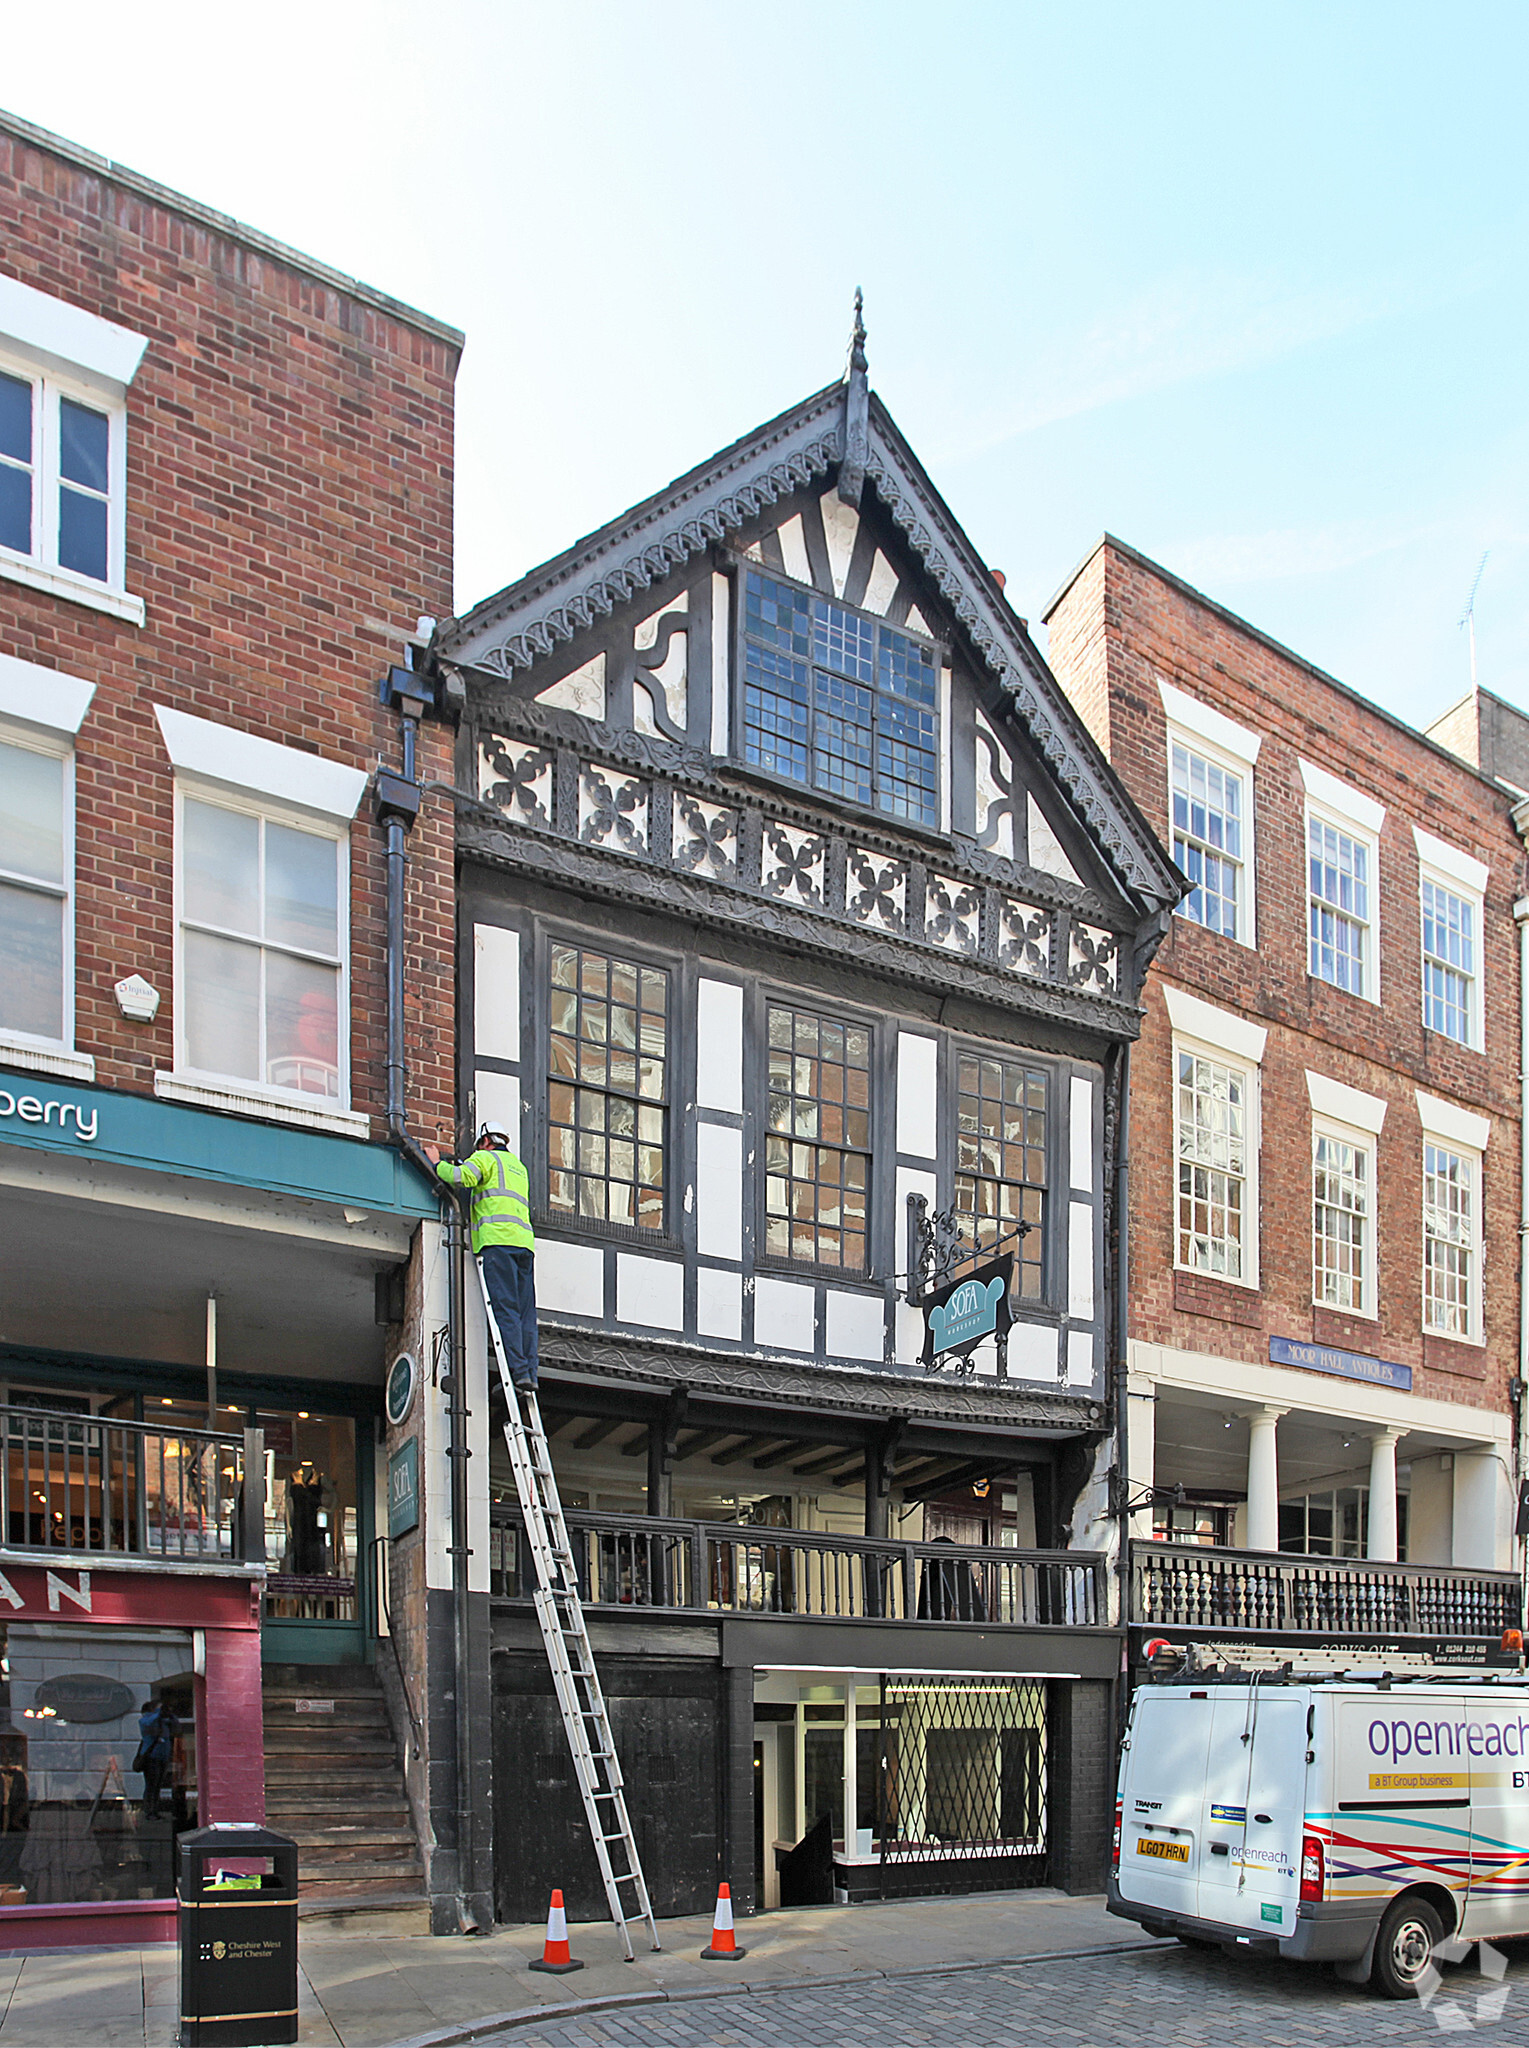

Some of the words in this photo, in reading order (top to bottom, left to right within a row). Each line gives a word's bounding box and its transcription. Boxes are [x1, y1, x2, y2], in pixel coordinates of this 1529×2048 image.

[951, 1285, 979, 1321] SOFA
[1287, 1344, 1316, 1363] MOOR
[1320, 1352, 1345, 1371] HALL
[1352, 1361, 1393, 1380] ANTIQUES
[393, 1462, 411, 1502] SOFA
[1368, 1715, 1529, 1765] openreach
[1375, 1777, 1381, 1787] a
[1382, 1775, 1392, 1787] BT
[1393, 1775, 1418, 1789] Group
[1419, 1773, 1454, 1787] business
[1135, 1800, 1163, 1810] TRANSIT
[1140, 1840, 1165, 1856] LG07
[1165, 1844, 1186, 1860] HRN
[1231, 1846, 1288, 1864] openreach
[1277, 1867, 1287, 1875] BT
[228, 1942, 261, 1951] Cheshire
[262, 1940, 282, 1949] West
[228, 1951, 243, 1959] and
[244, 1949, 273, 1958] Chester
